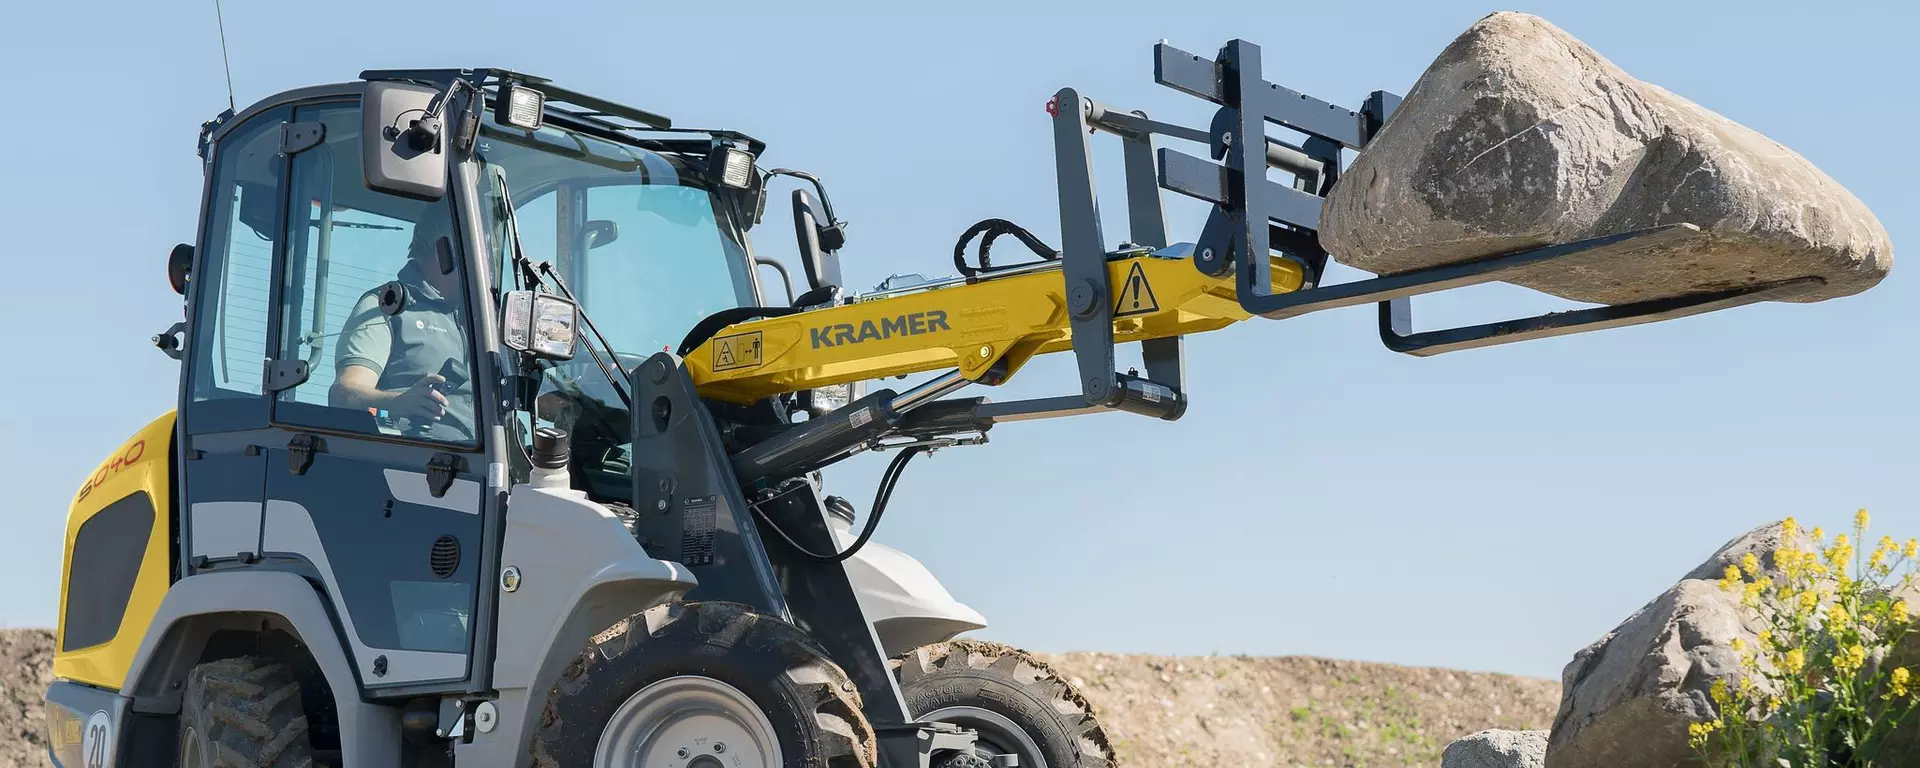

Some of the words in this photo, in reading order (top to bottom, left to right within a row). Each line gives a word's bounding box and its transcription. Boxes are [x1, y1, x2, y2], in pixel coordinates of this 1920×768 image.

[809, 309, 952, 349] KRAMER
[78, 439, 145, 503] 5040
[905, 684, 965, 708] RACTOR
[88, 724, 107, 768] 20
